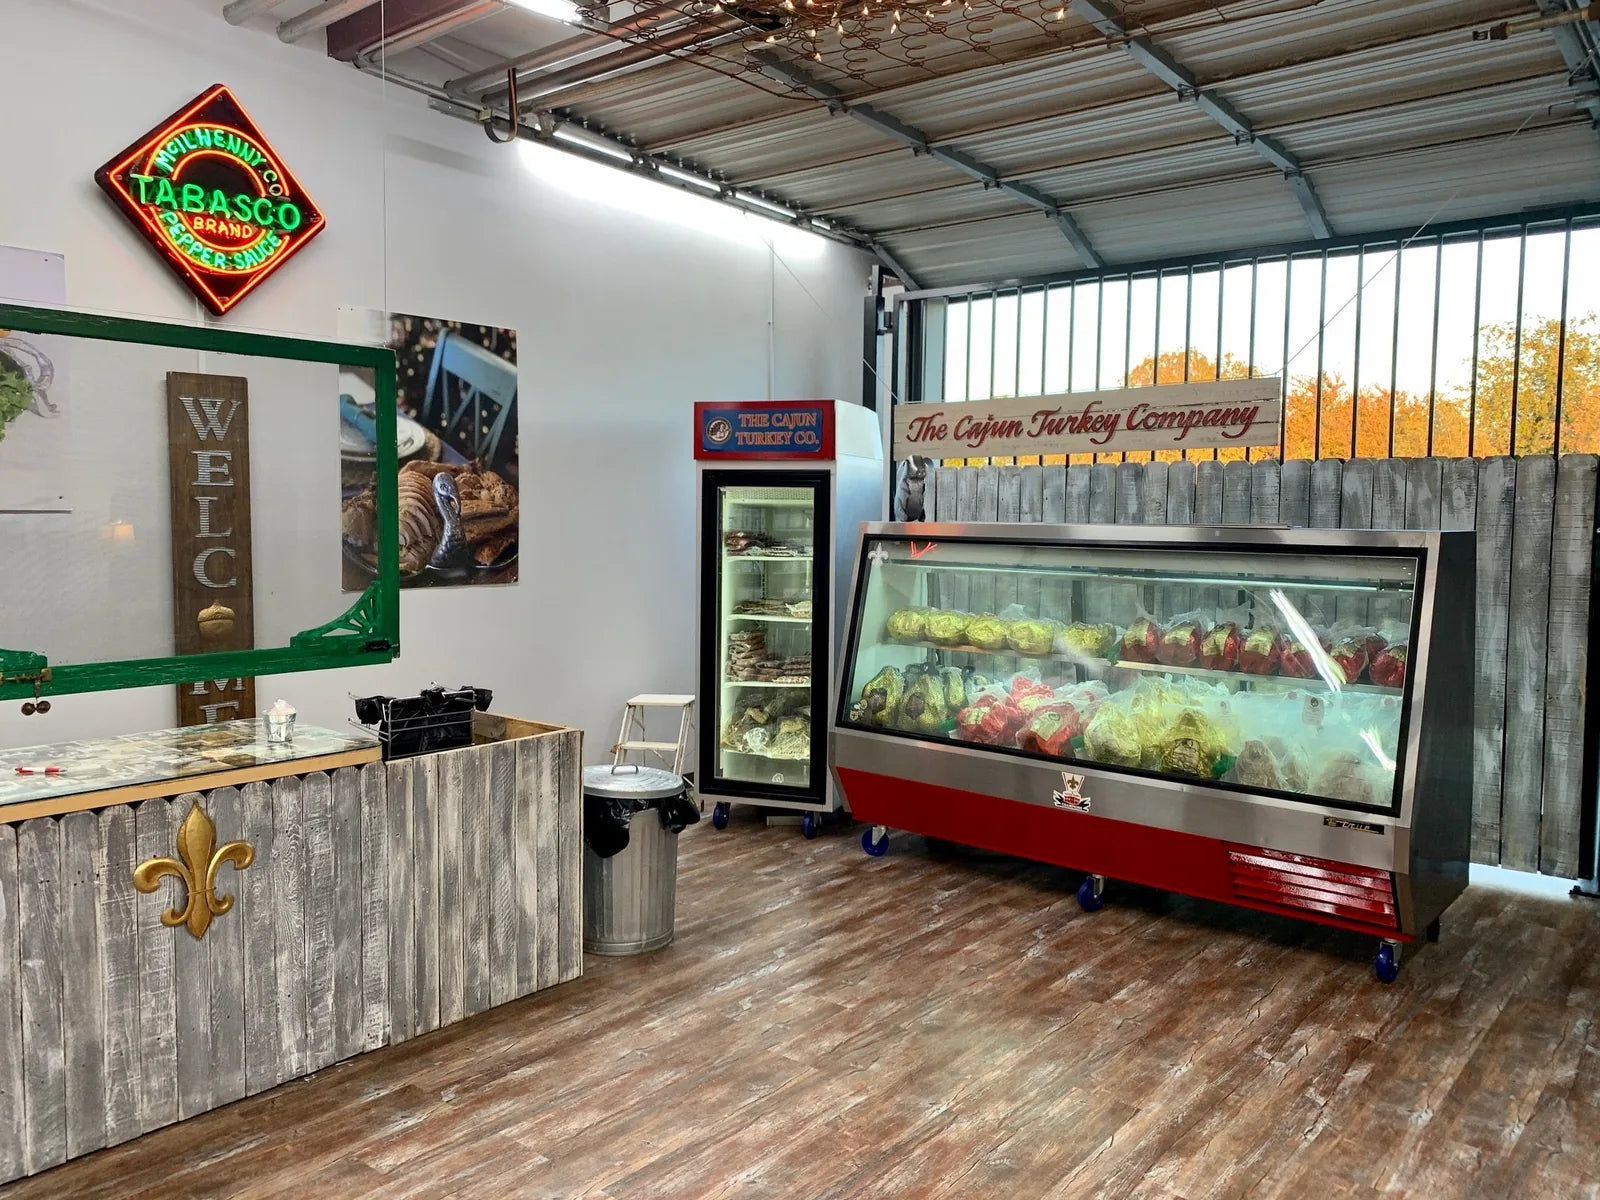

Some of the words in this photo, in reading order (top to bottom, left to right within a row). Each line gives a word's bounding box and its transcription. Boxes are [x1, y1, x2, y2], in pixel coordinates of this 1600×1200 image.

[130, 173, 301, 231] TABASCO
[159, 210, 227, 269] PEPPER
[233, 230, 282, 270] SAUCE
[193, 216, 252, 239] BRAND
[735, 431, 792, 445] TURKEY
[794, 431, 819, 445] CO.
[738, 413, 769, 427] THE
[772, 413, 817, 429] CAJUN
[906, 411, 948, 442] The
[953, 414, 1024, 449] Cajun
[1027, 400, 1121, 444] Turkey
[1126, 402, 1260, 441] Company
